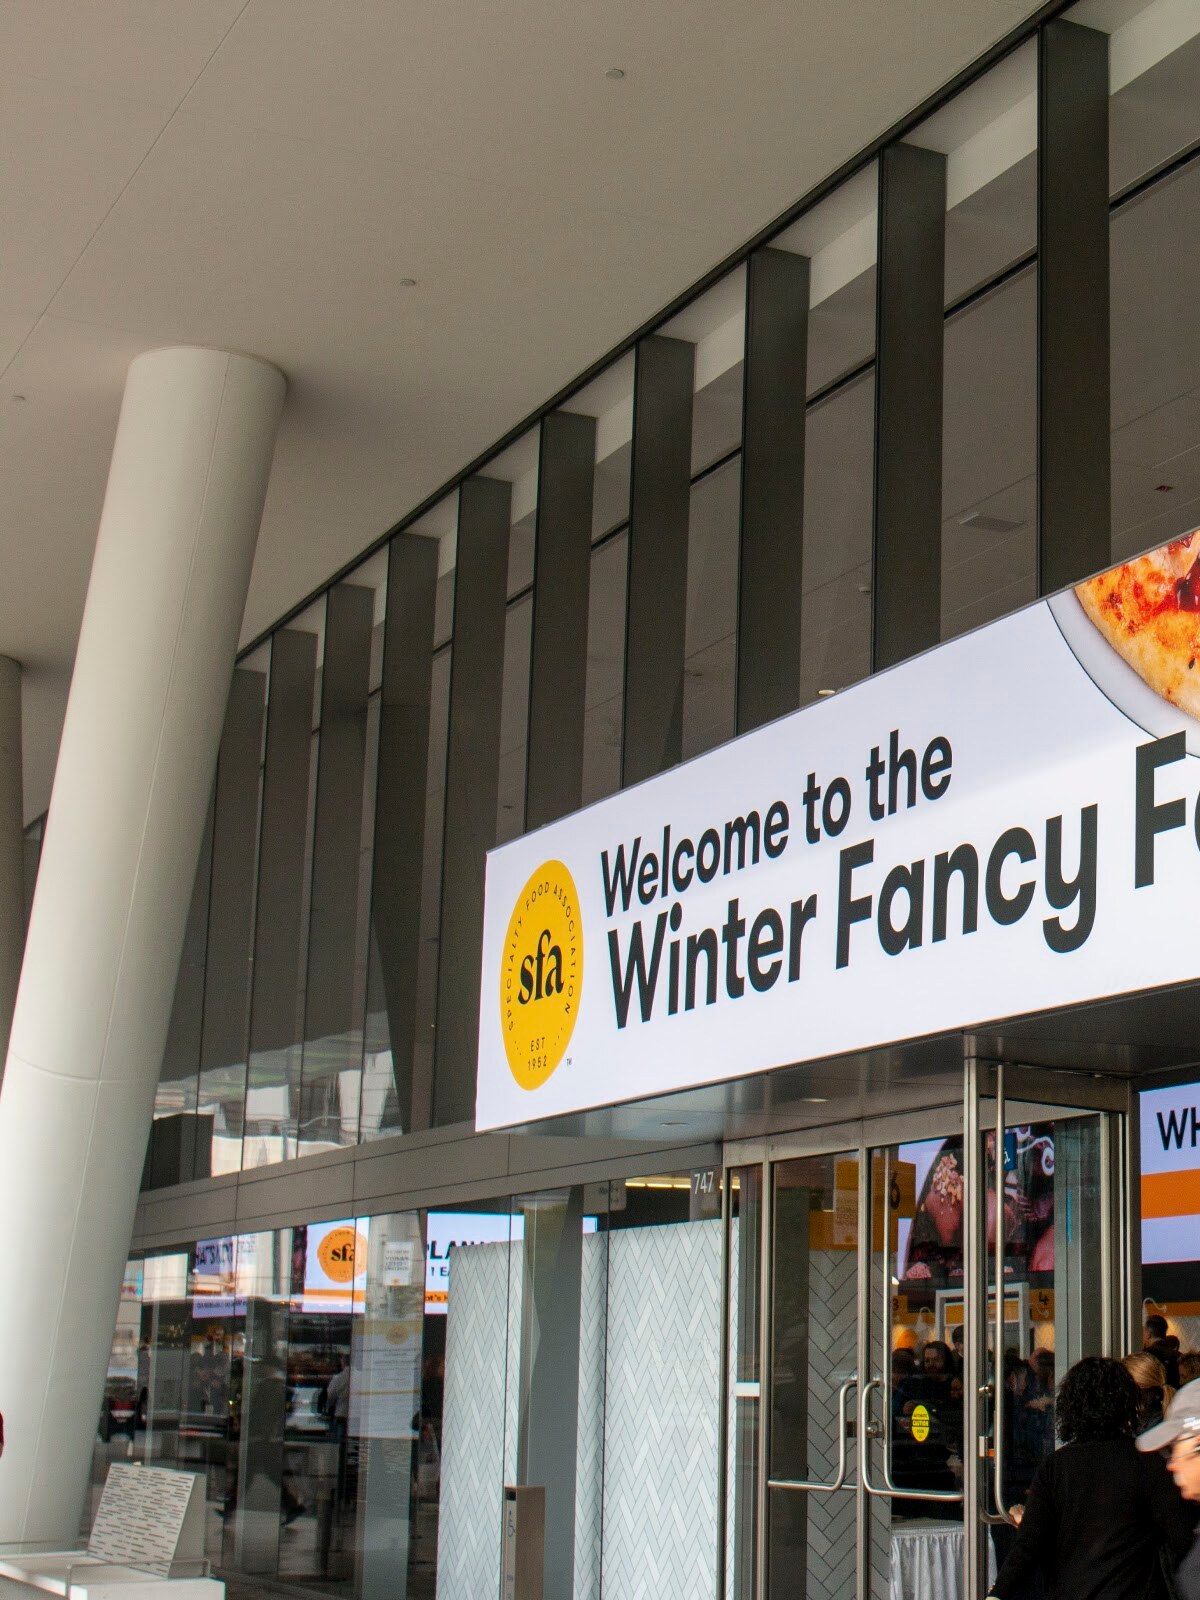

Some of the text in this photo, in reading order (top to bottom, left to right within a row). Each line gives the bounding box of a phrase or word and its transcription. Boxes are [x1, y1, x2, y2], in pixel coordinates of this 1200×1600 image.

[600, 729, 953, 917] Welcome to the
[607, 893, 817, 1030] Winter
[836, 803, 1098, 954] Fancy
[507, 881, 577, 1031] SPECIALTY FOOD ASSOCIATION
[518, 929, 564, 1005] sfa
[528, 1057, 547, 1071] 1952
[530, 1037, 545, 1052] EST
[694, 1171, 714, 1194] 747
[1038, 1292, 1048, 1305] 4
